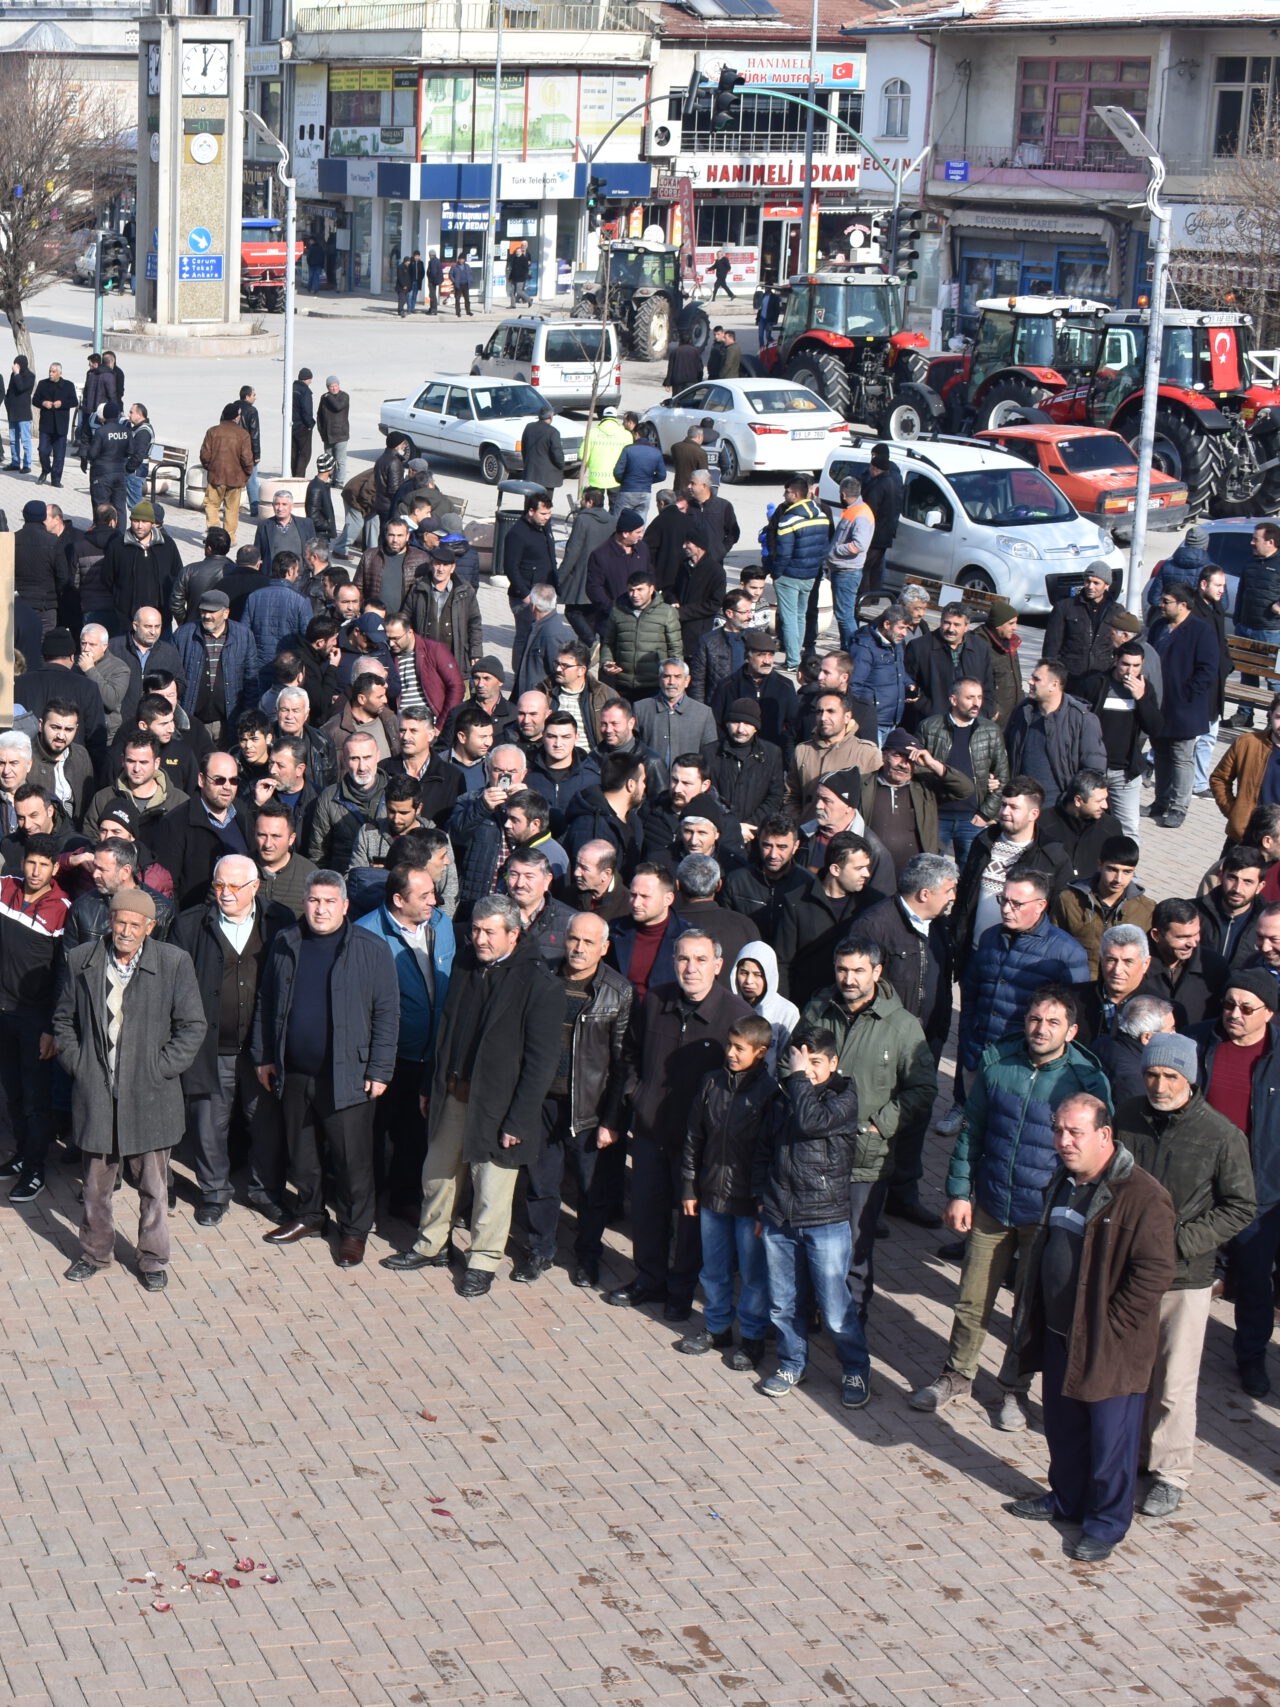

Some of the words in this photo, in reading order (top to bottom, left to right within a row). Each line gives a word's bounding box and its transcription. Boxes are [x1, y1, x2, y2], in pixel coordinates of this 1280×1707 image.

[707, 160, 793, 185] HANIMELİ
[799, 164, 857, 182] LOKAN
[511, 175, 527, 185] Türk
[448, 221, 453, 230] 3
[454, 221, 465, 230] AY
[465, 221, 488, 230] BEDAV
